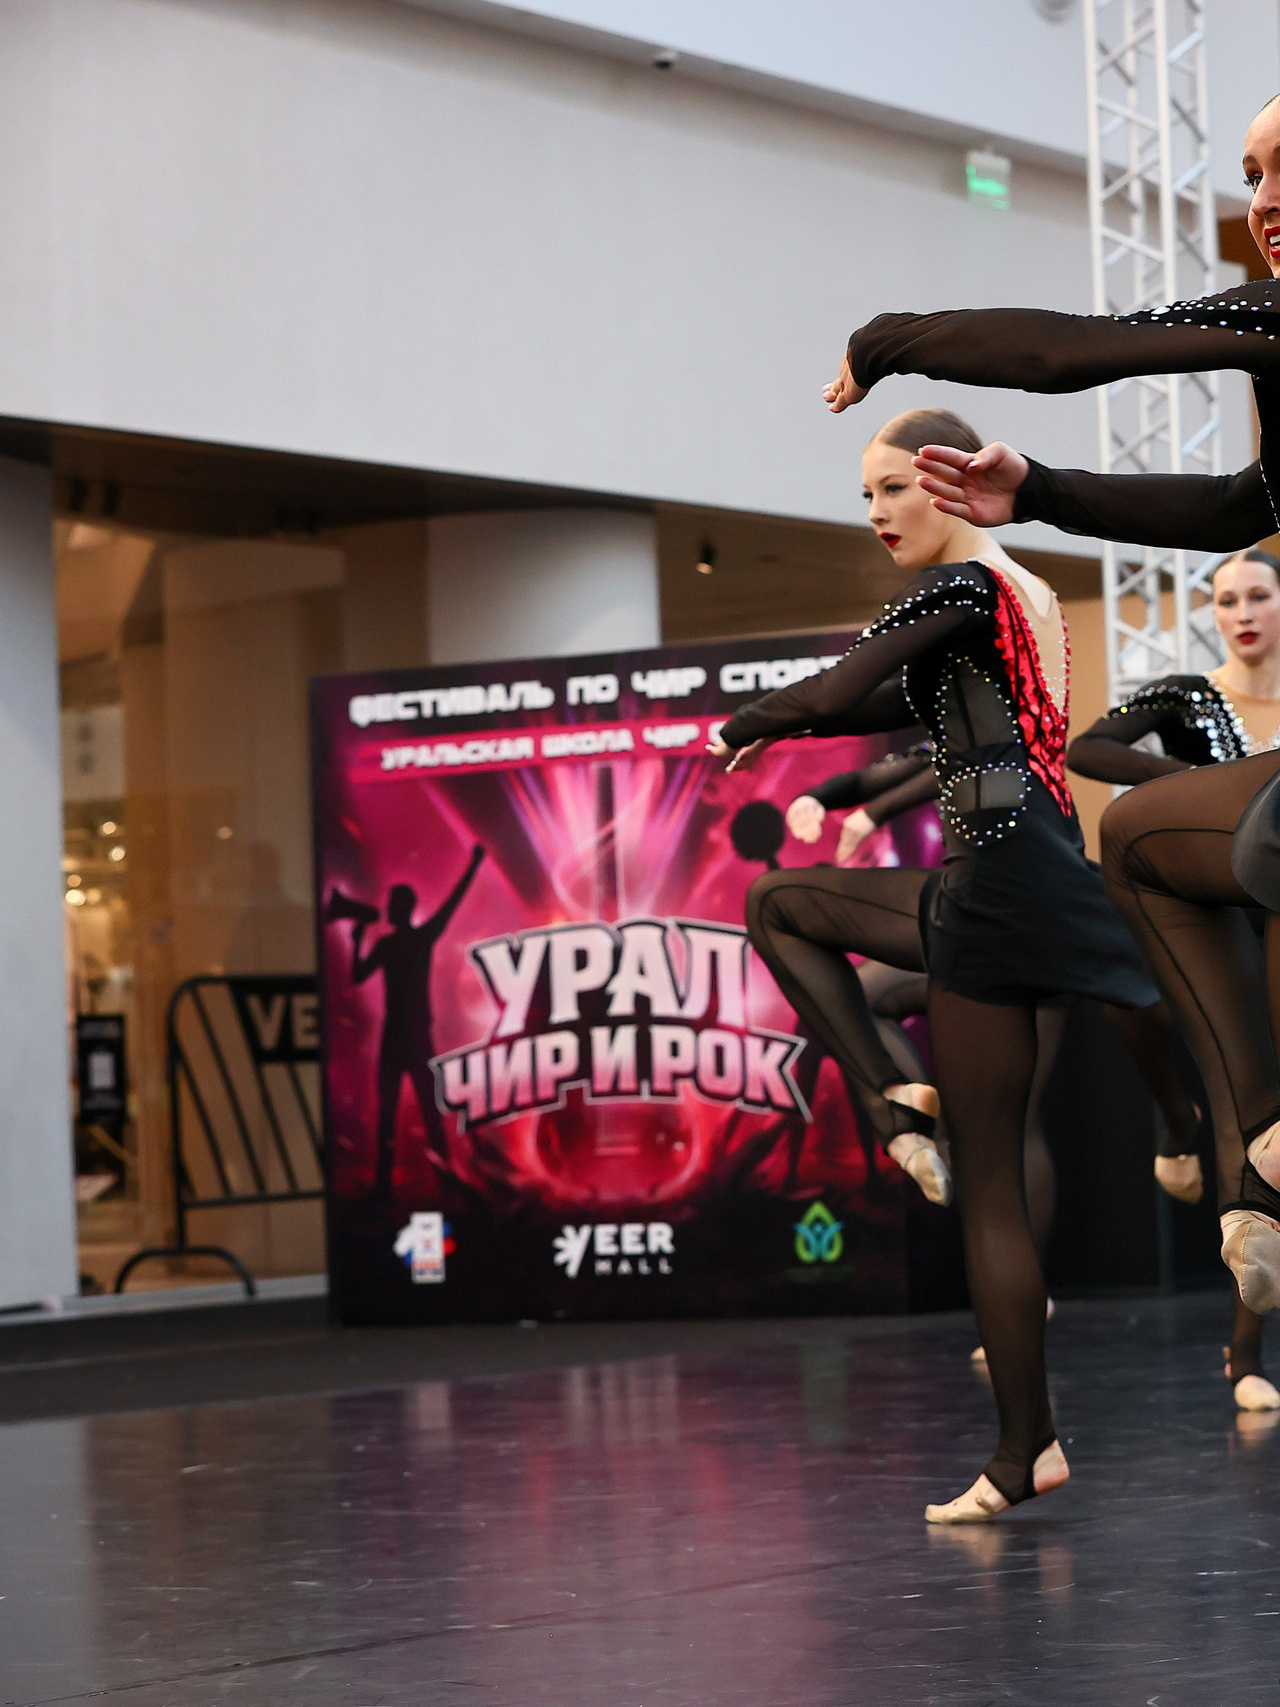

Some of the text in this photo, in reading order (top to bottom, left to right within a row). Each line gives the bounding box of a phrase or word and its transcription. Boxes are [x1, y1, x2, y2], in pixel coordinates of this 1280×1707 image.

[349, 680, 555, 727] ФЕСТИВАЛЬ
[566, 673, 619, 704] ПО
[631, 666, 707, 699] ЧИР
[381, 736, 534, 770] УРАЛЬСКАЯ
[541, 728, 635, 758] ШКОЛА
[642, 723, 700, 748] ЧИР
[475, 922, 749, 1037] УРАЛ
[442, 1023, 796, 1121] ЧИР И РОК
